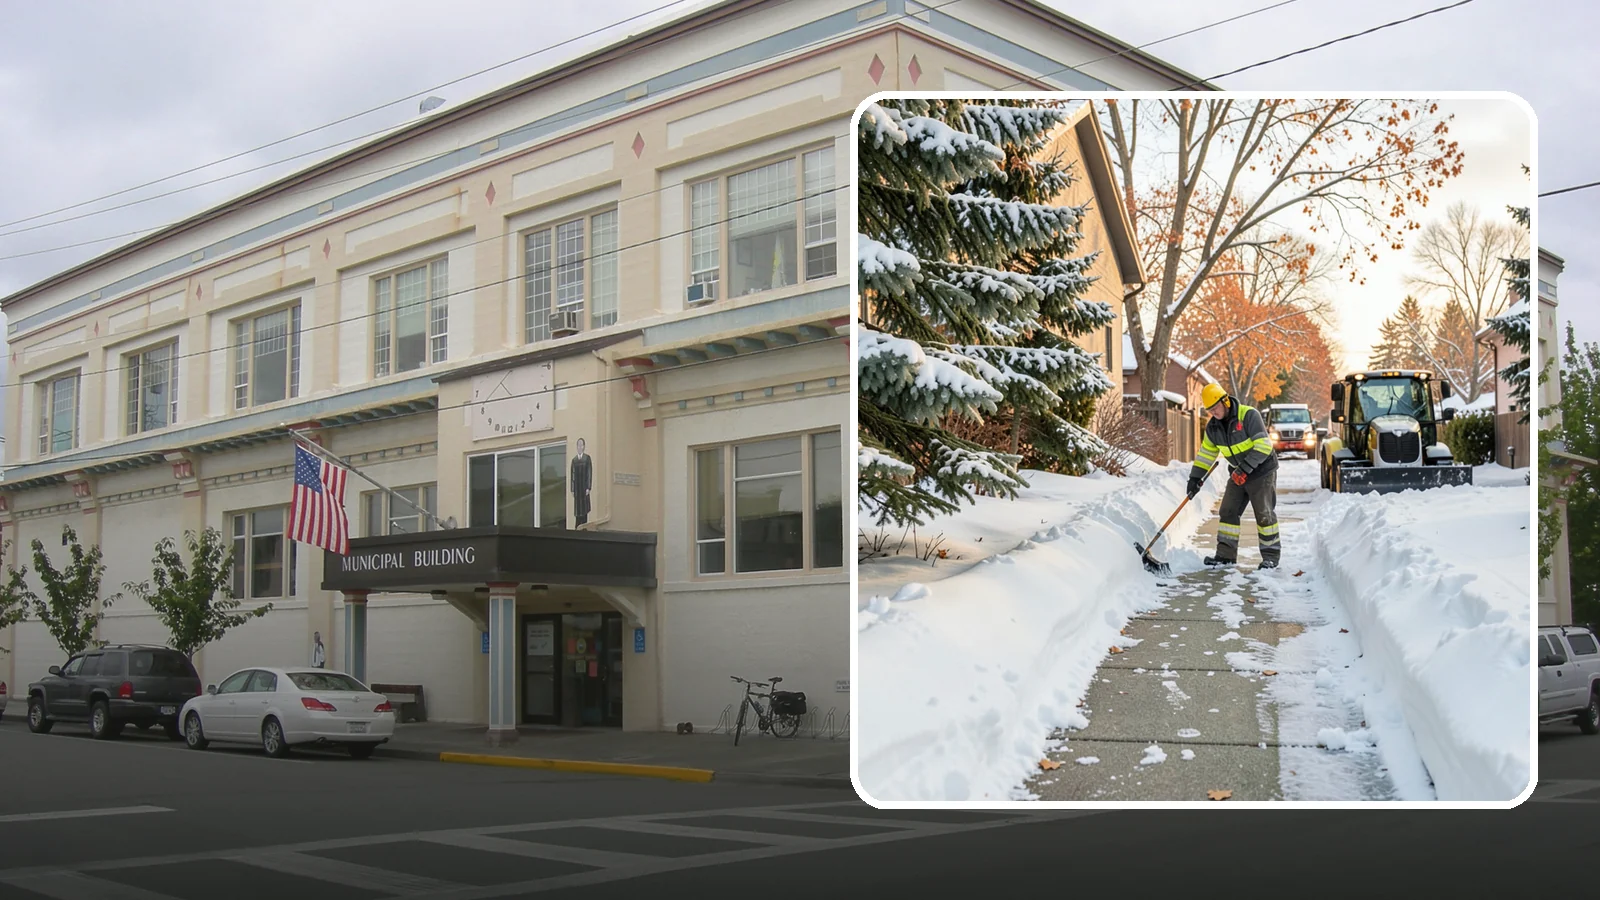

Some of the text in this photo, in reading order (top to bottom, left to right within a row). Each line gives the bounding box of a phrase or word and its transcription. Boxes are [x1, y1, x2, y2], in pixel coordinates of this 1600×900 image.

[480, 407, 485, 415] 8
[536, 402, 540, 410] 4
[487, 417, 492, 425] 9
[507, 425, 513, 433] 12
[521, 420, 526, 428] 2
[528, 413, 533, 422] 3
[342, 546, 475, 572] MUNICIPAL BUILDING
